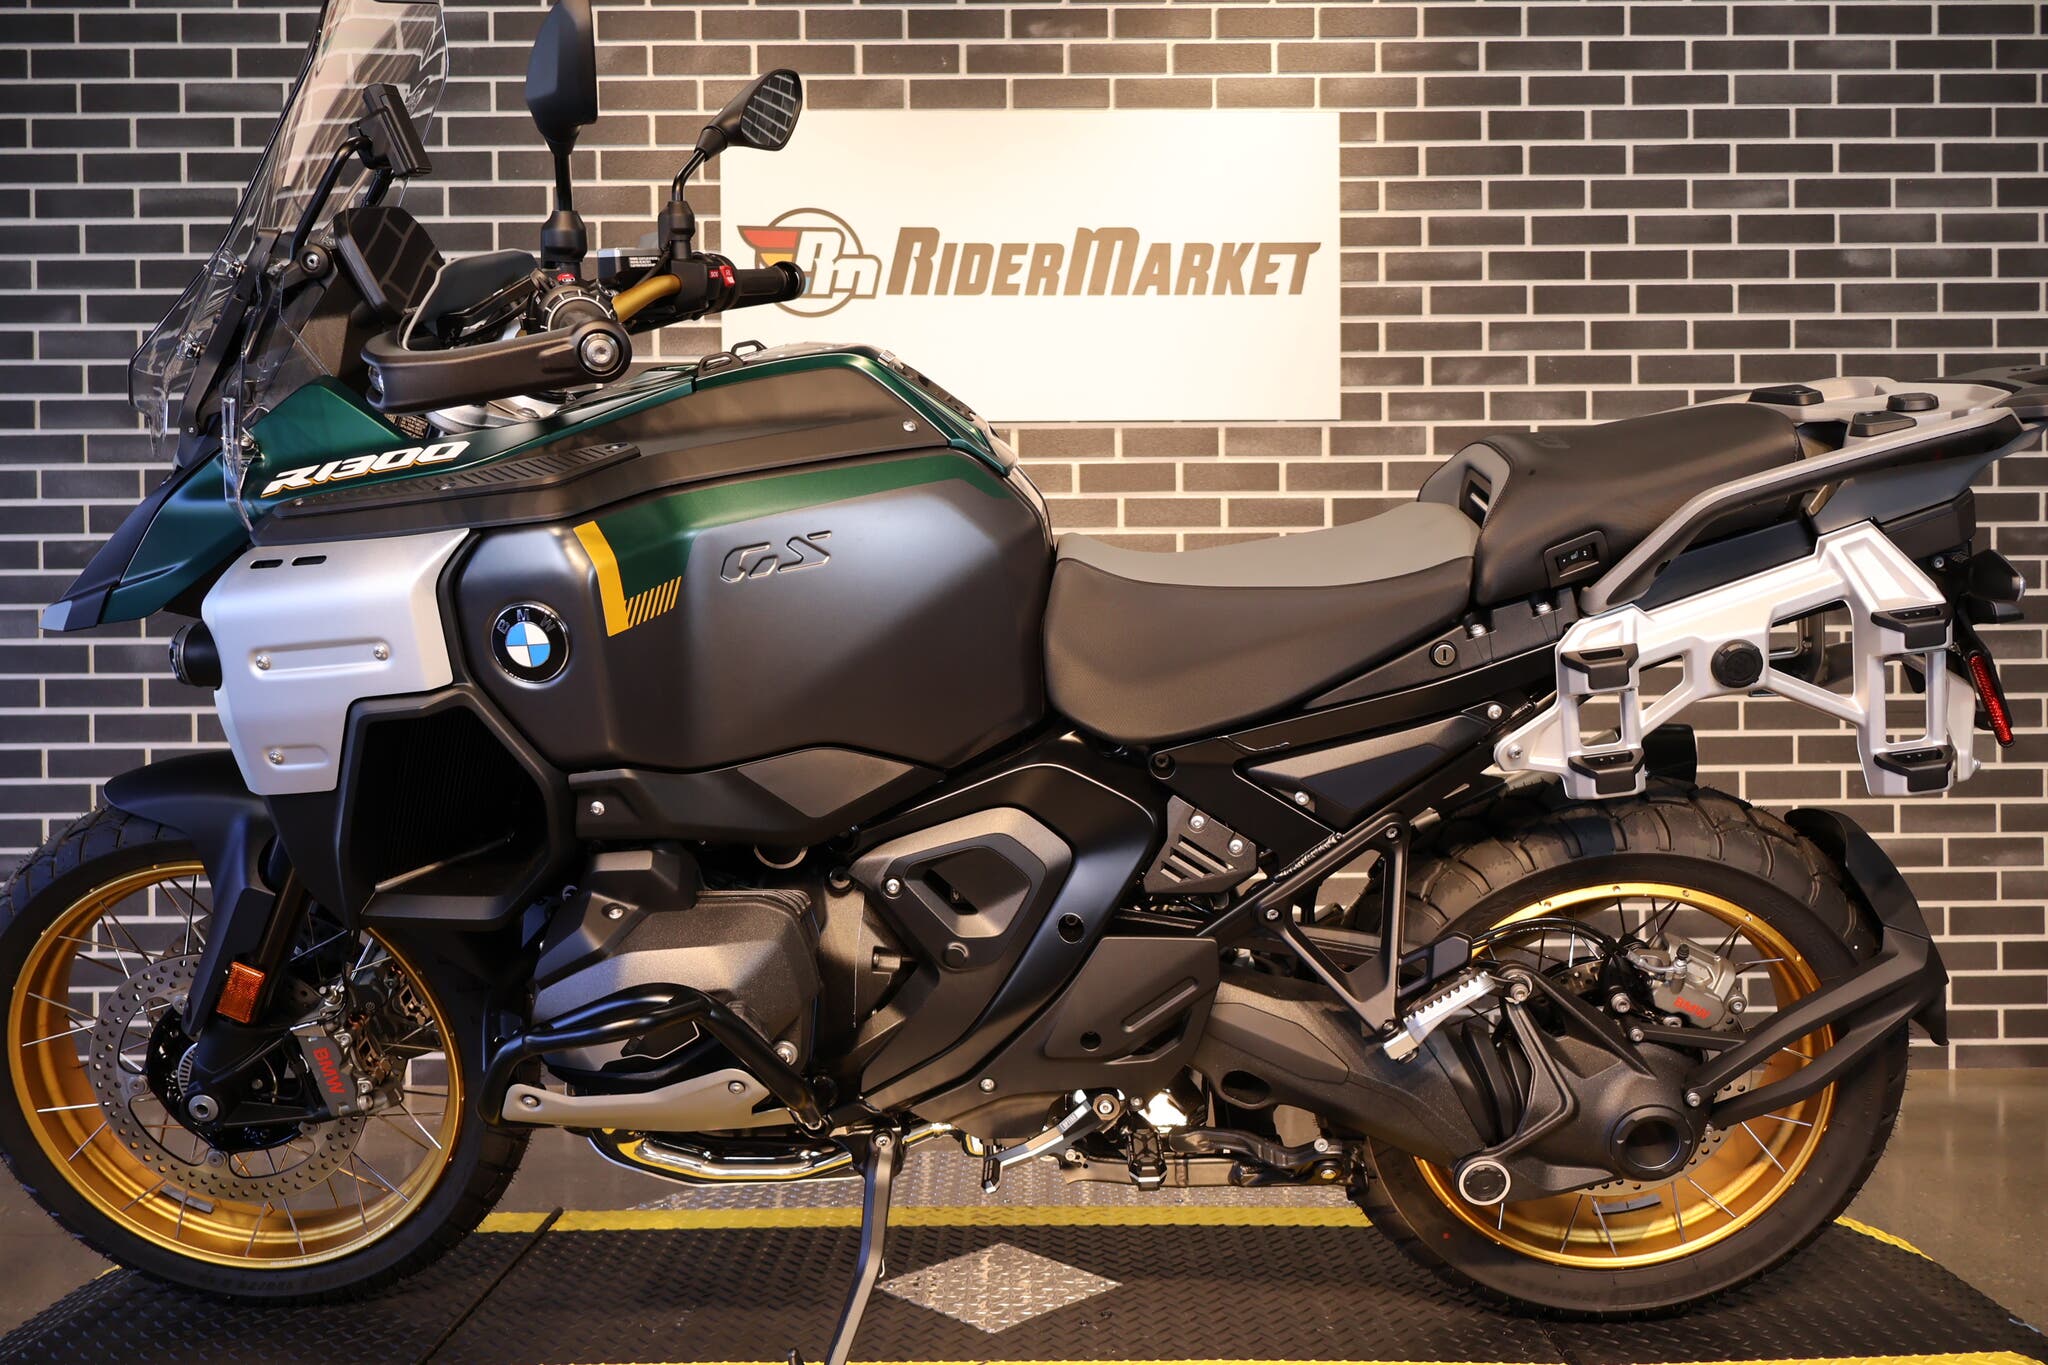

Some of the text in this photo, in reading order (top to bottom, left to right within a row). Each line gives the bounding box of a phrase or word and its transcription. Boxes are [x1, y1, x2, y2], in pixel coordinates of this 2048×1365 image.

[260, 440, 471, 498] R1300
[720, 530, 832, 583] GS
[496, 608, 557, 635] BMW
[1674, 997, 1711, 1020] BMW
[313, 1046, 346, 1093] BMW
